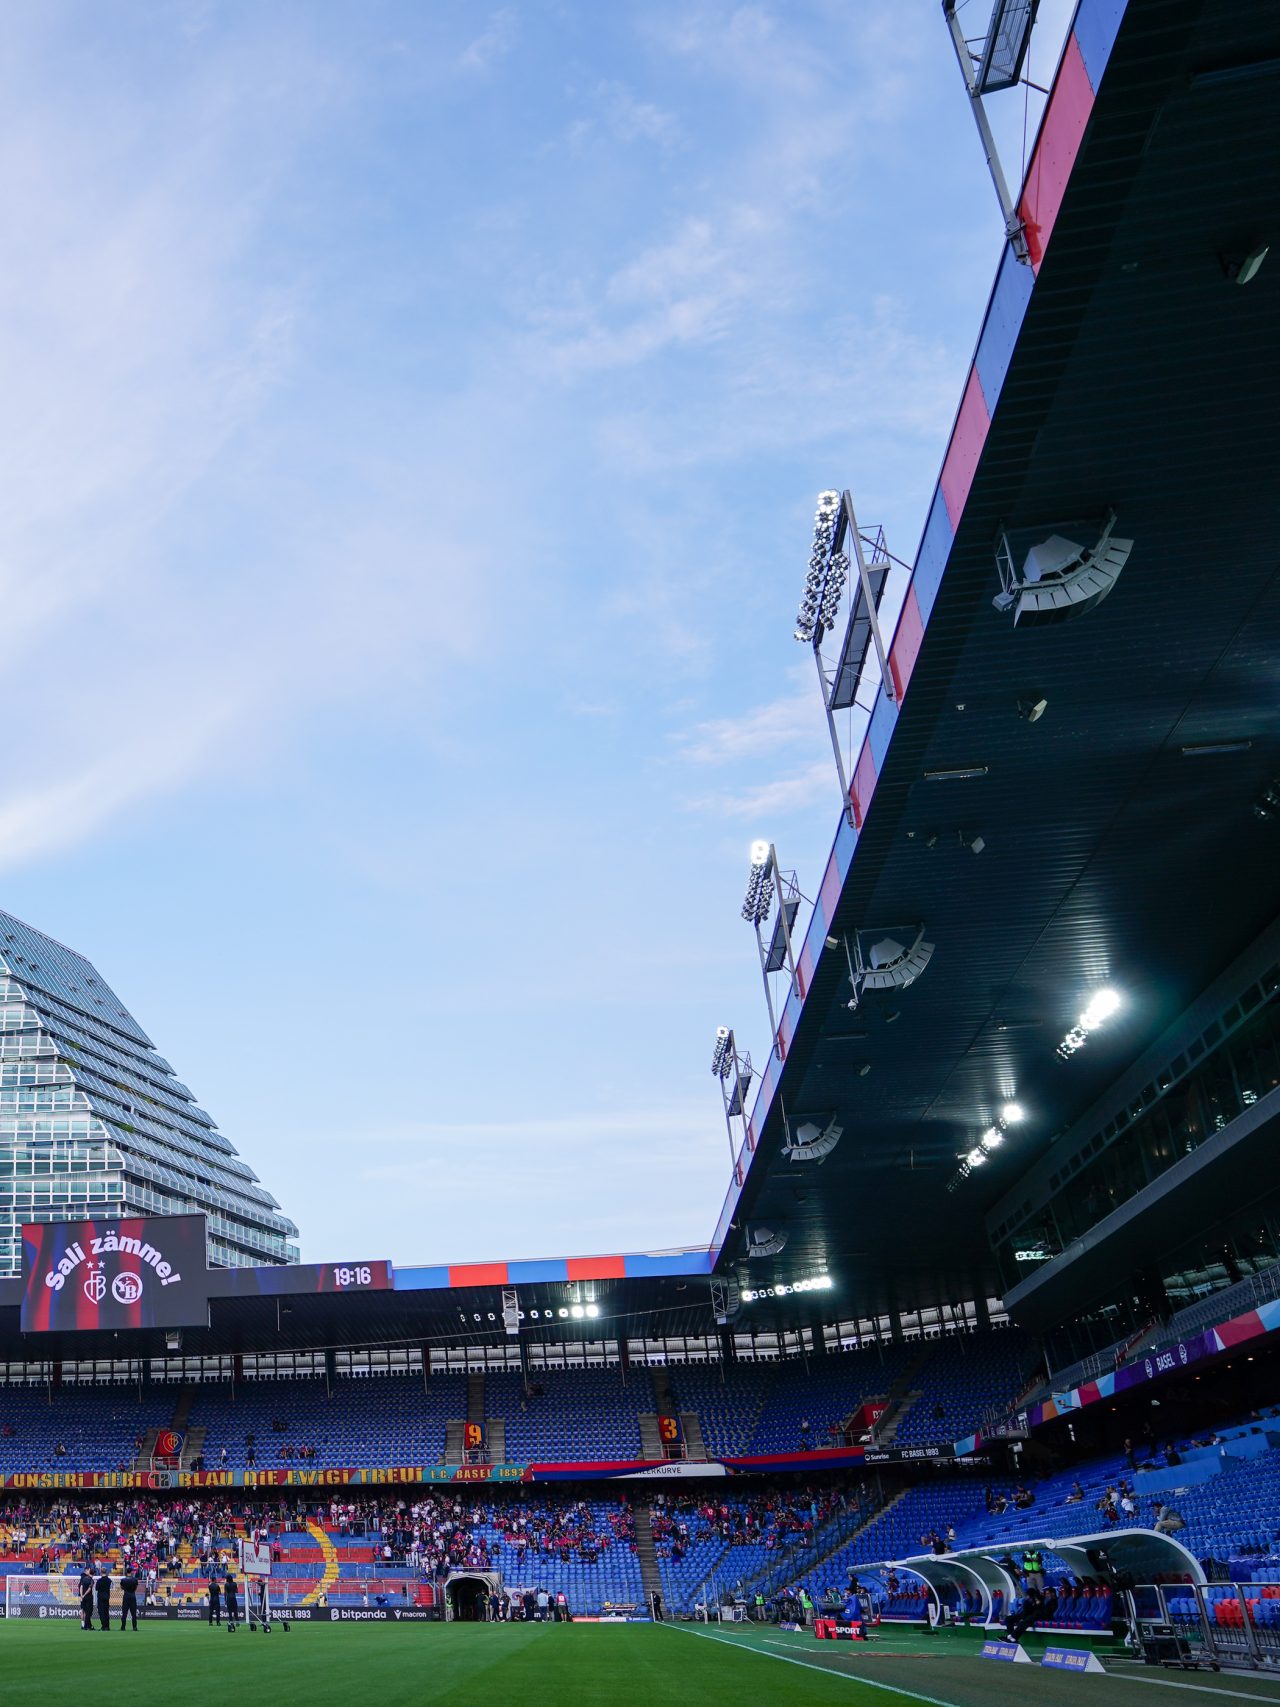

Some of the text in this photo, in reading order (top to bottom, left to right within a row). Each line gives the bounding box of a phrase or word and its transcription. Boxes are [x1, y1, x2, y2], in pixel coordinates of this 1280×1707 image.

[45, 1242, 86, 1291] Sali
[89, 1230, 182, 1286] zämme!
[333, 1266, 371, 1286] 19:16
[1156, 1352, 1176, 1372] BASEL
[469, 1424, 482, 1445] 9
[664, 1418, 678, 1441] 3
[901, 1448, 939, 1458] FC BASEL 1893
[178, 1471, 234, 1487] BLAU
[456, 1469, 493, 1479] BASEL
[499, 1468, 525, 1477] 1893
[48, 1606, 82, 1619] bitpan
[272, 1610, 293, 1619] BASEL
[294, 1609, 311, 1619] 1893
[341, 1608, 387, 1621] bitpanda
[836, 1626, 861, 1634] SPORT
